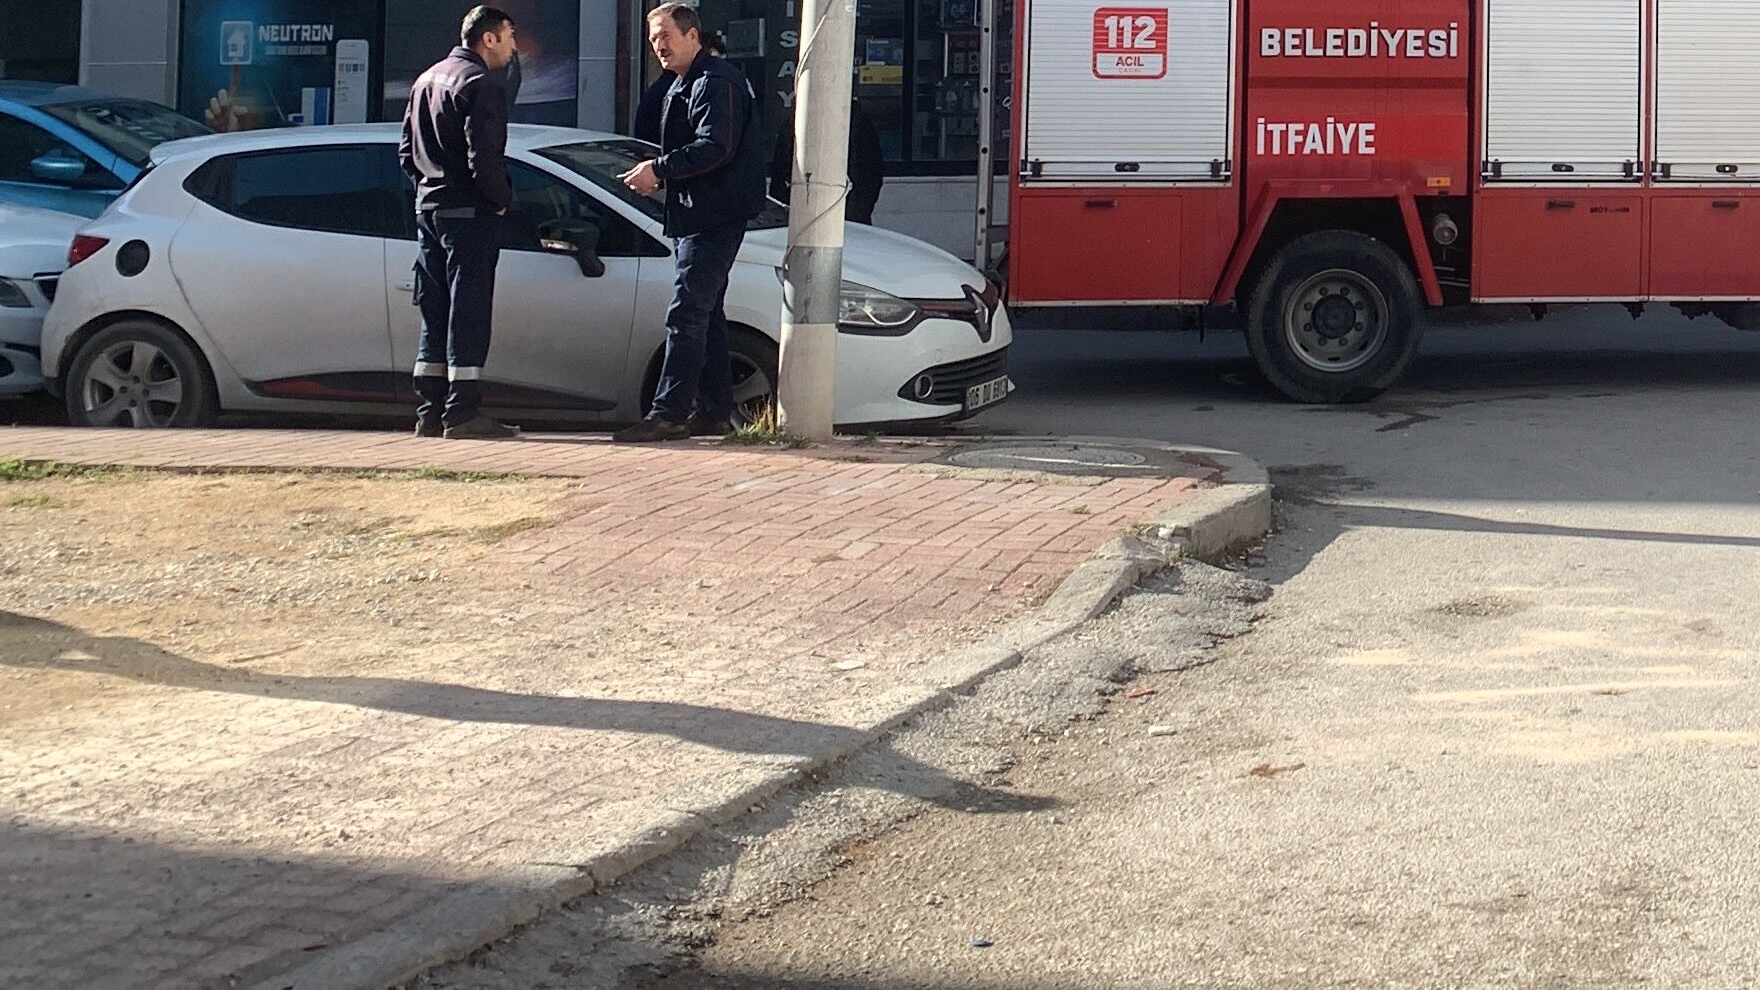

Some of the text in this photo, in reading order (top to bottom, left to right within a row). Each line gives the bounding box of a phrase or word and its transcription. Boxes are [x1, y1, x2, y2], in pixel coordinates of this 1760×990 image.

[258, 24, 334, 42] NEUTRON
[1104, 15, 1157, 49] 112
[1261, 21, 1458, 57] BELEDİYESİ
[1256, 116, 1376, 155] İTFAİYE
